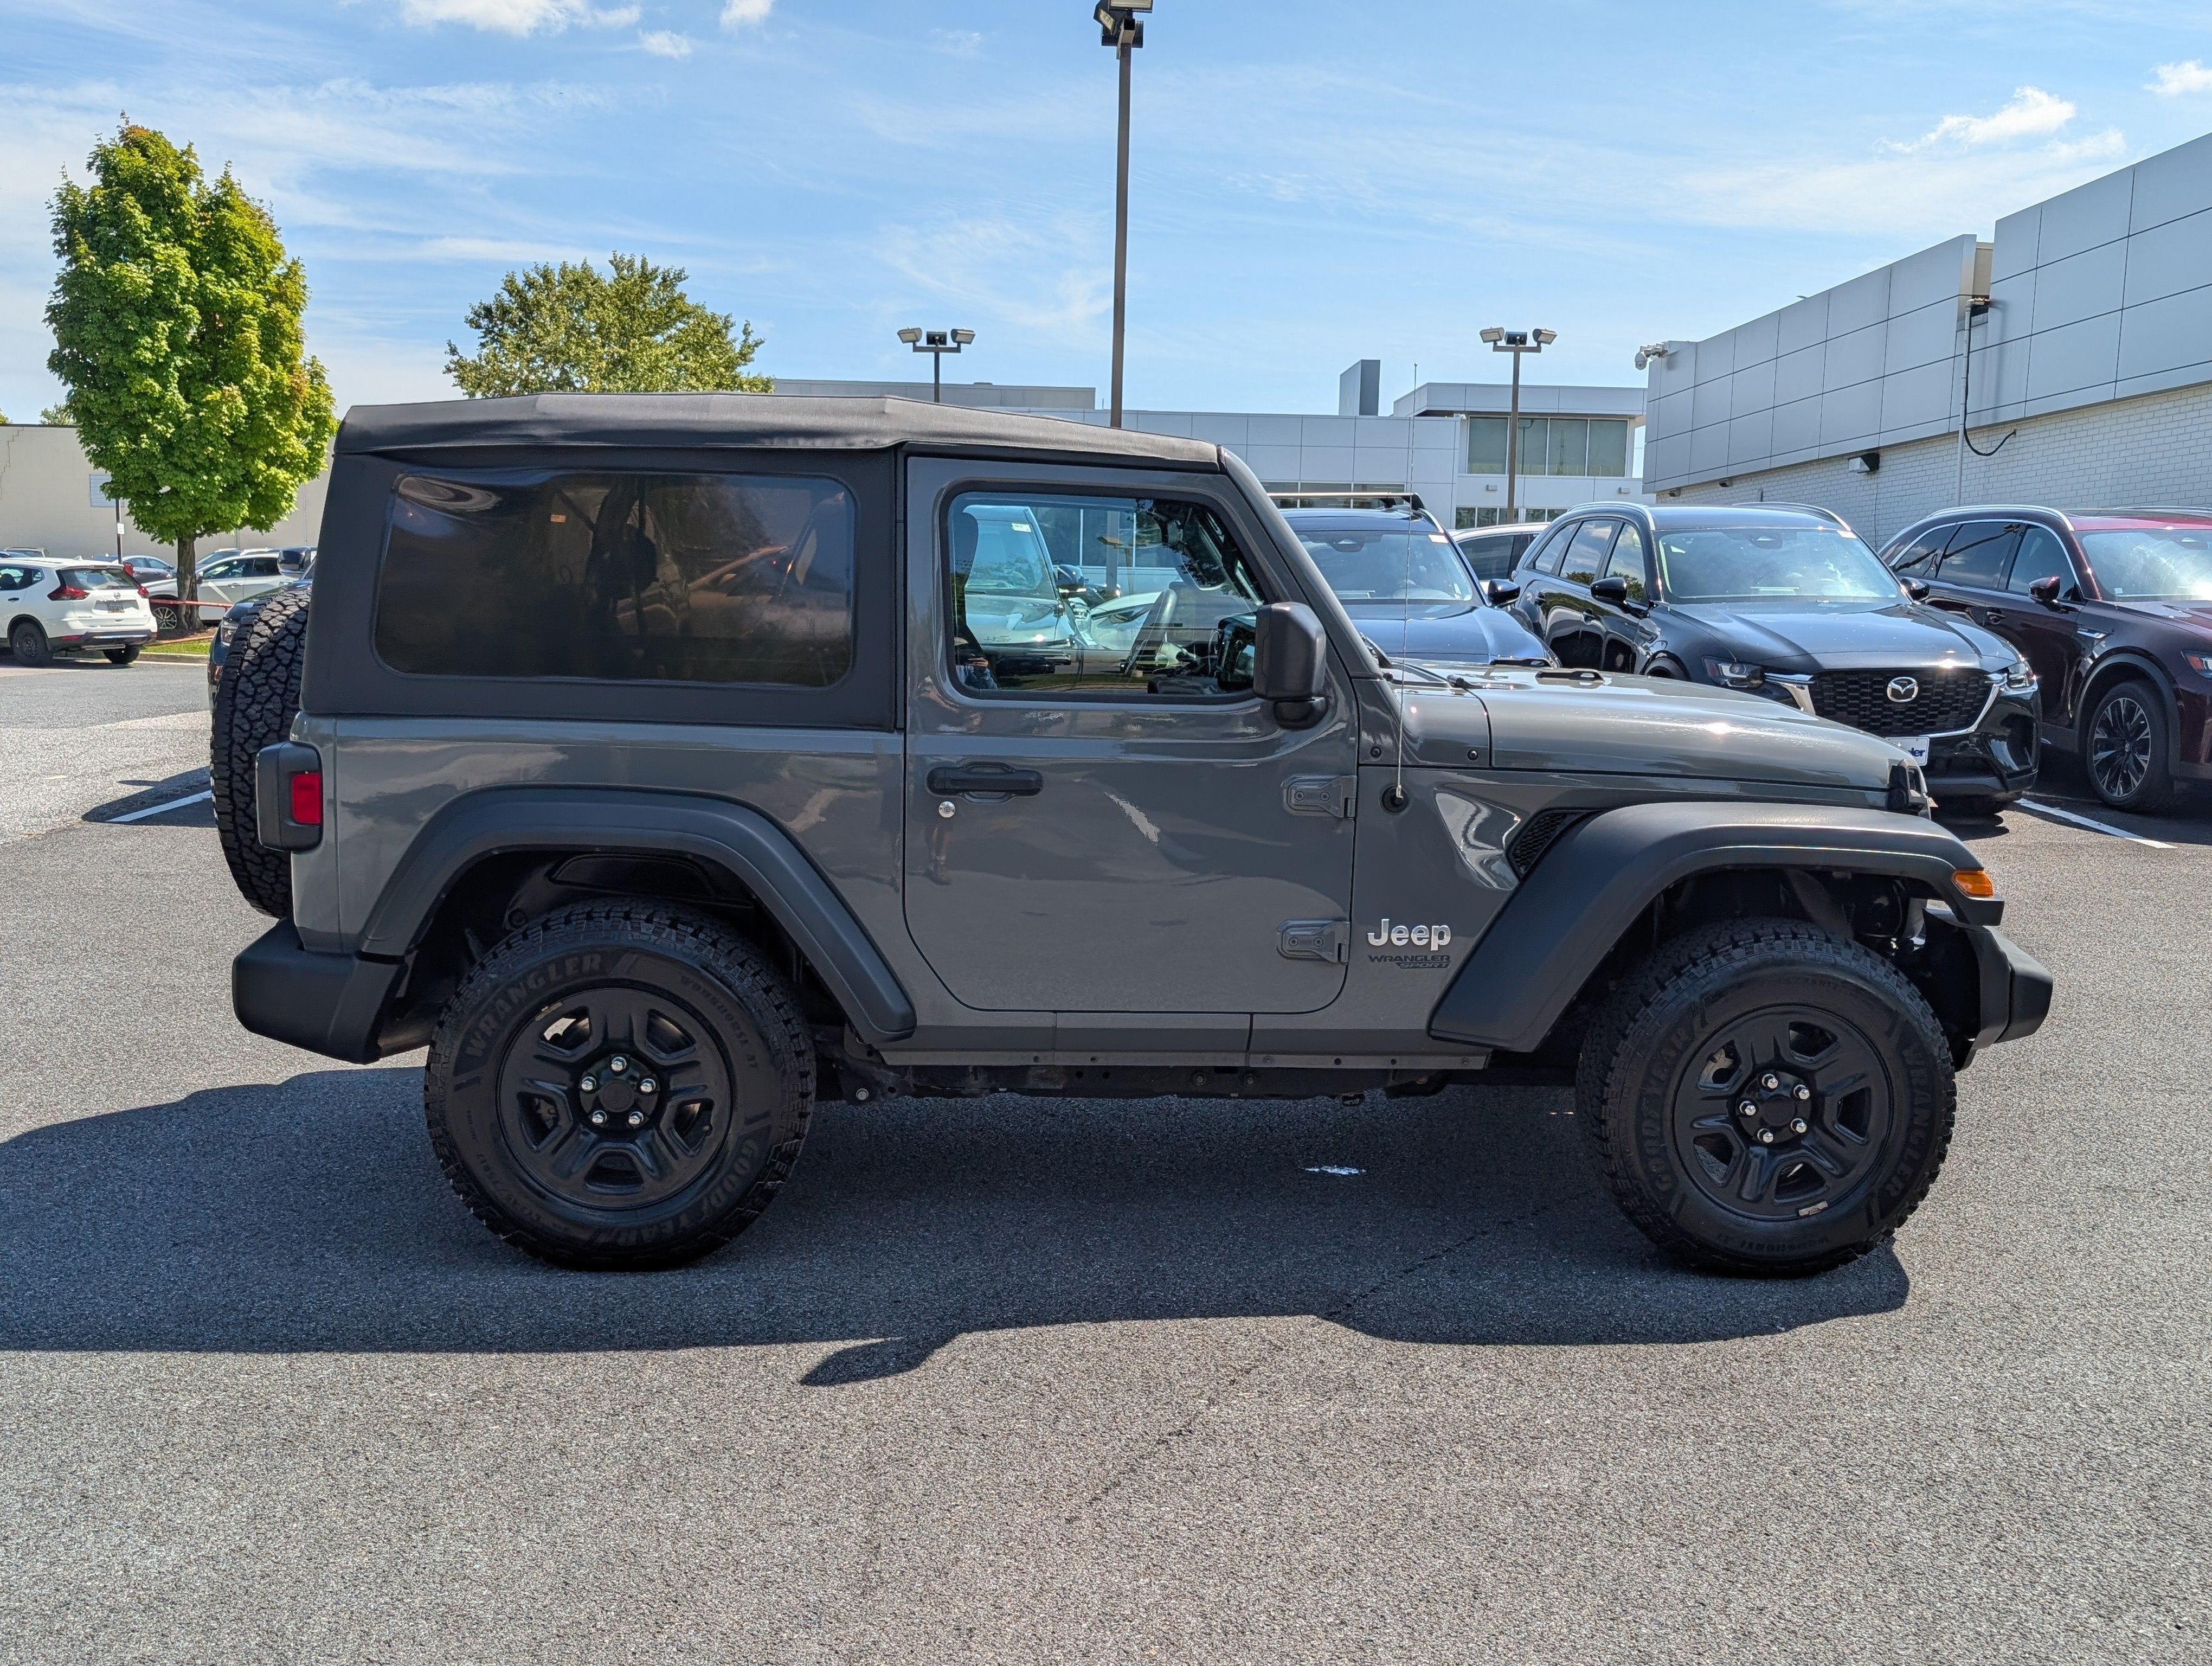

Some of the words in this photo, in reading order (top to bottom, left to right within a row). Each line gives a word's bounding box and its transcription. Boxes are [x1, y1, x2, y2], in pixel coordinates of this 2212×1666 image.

[1367, 918, 1451, 951] Jeep
[464, 953, 603, 1058] WRANGLER
[1886, 1048, 1935, 1197] WRANGLER
